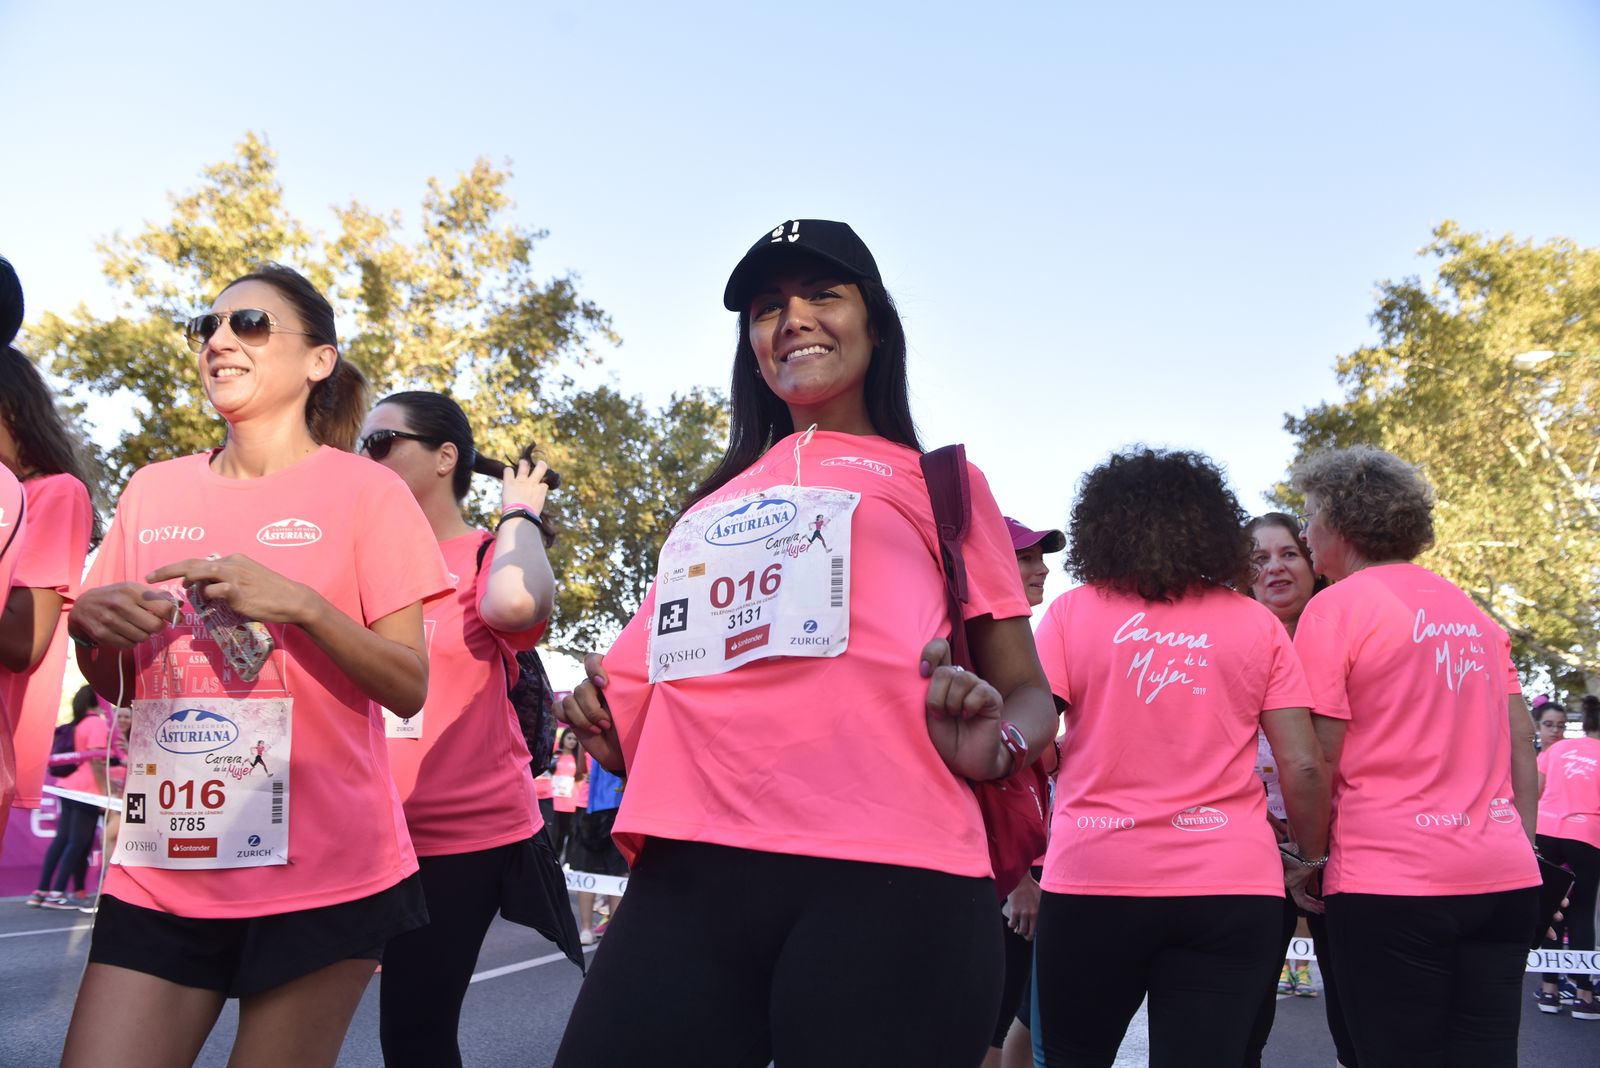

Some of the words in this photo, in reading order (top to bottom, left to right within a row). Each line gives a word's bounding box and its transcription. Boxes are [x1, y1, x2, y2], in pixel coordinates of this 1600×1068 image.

[711, 510, 789, 540] ASTURIANA
[138, 526, 205, 544] OYSHO
[261, 529, 316, 540] ASTURIANA
[765, 533, 800, 550] Carrera
[709, 563, 783, 609] 016
[727, 606, 761, 630] 3131
[1413, 608, 1483, 643] Carrera
[1112, 611, 1214, 649] Carrera
[737, 632, 764, 649] Santander
[790, 636, 830, 646] ZURICH
[659, 648, 706, 665] OYSHO
[1184, 652, 1195, 667] de
[1126, 647, 1194, 705] Mujer
[1435, 640, 1484, 696] Mujer
[192, 676, 220, 693] LAS
[1192, 686, 1207, 696] 2019
[159, 727, 230, 743] ASTURIANA
[205, 753, 243, 764] Carrera
[225, 763, 254, 780] Mujer
[159, 779, 226, 810] 016
[170, 817, 205, 831] 8785
[1077, 816, 1135, 830] OYSHO
[1176, 814, 1224, 826] ASTURIANA
[125, 841, 157, 852] OYSHO
[179, 844, 211, 852] Santander
[236, 850, 272, 858] ZURICH
